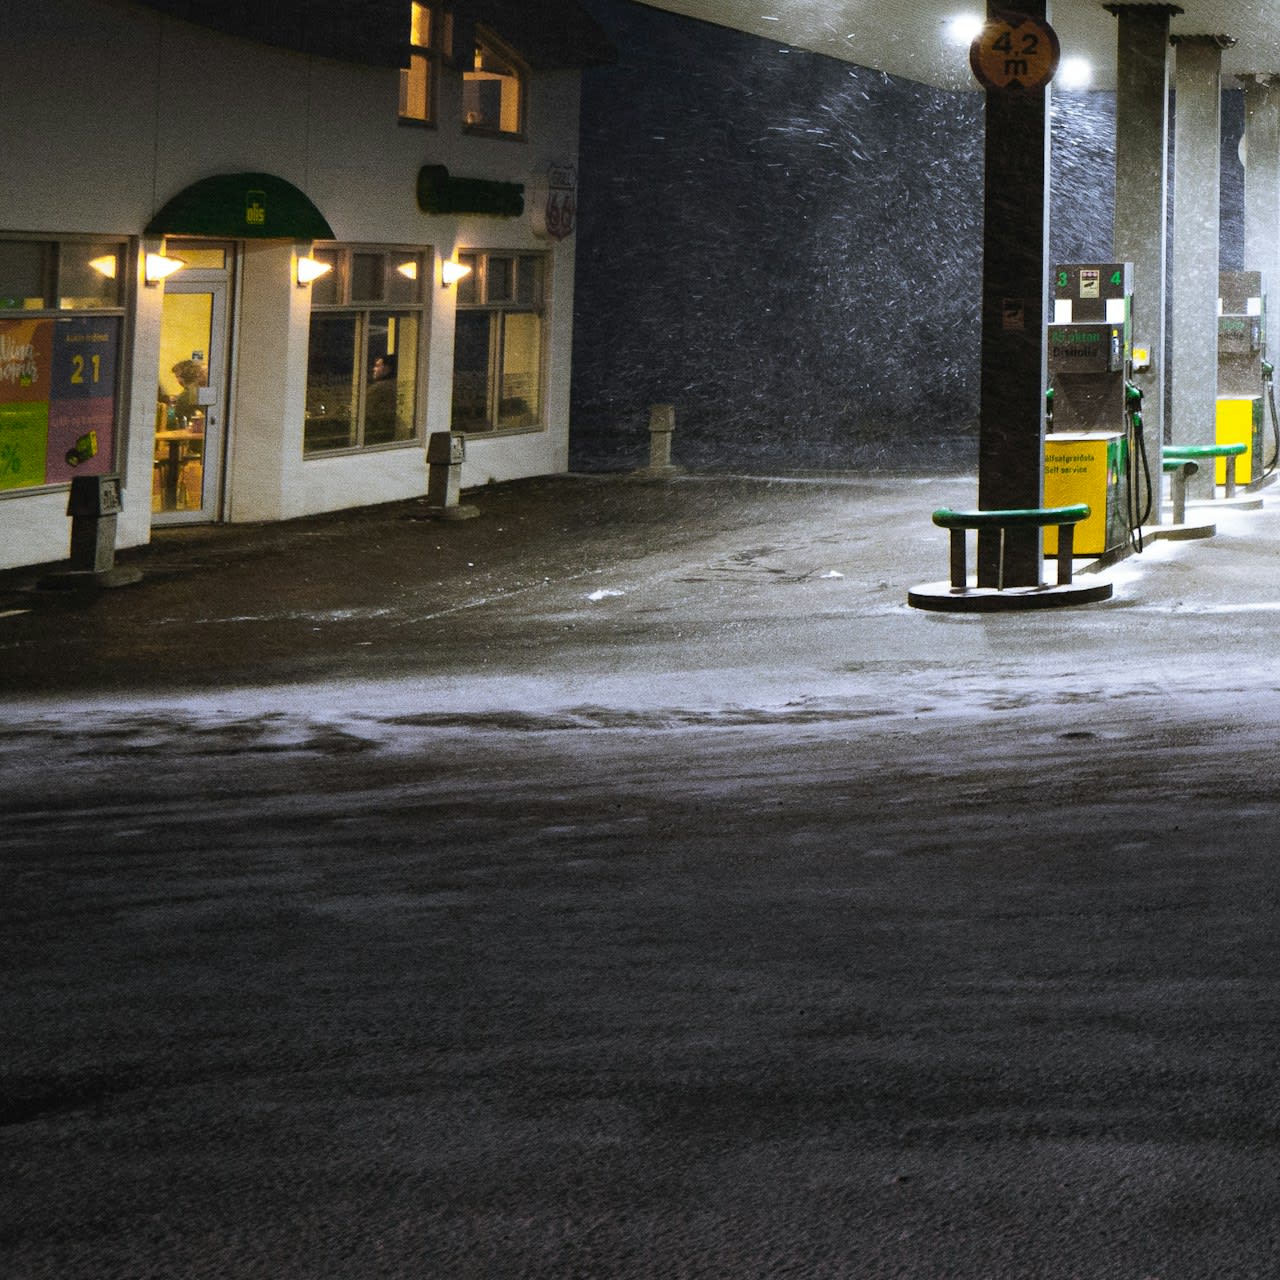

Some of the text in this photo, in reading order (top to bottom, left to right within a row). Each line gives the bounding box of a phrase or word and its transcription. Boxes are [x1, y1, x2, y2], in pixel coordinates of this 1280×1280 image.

[992, 31, 1040, 57] 4,2
[1004, 60, 1028, 76] m
[1057, 271, 1068, 288] 3
[1110, 271, 1121, 286] 4
